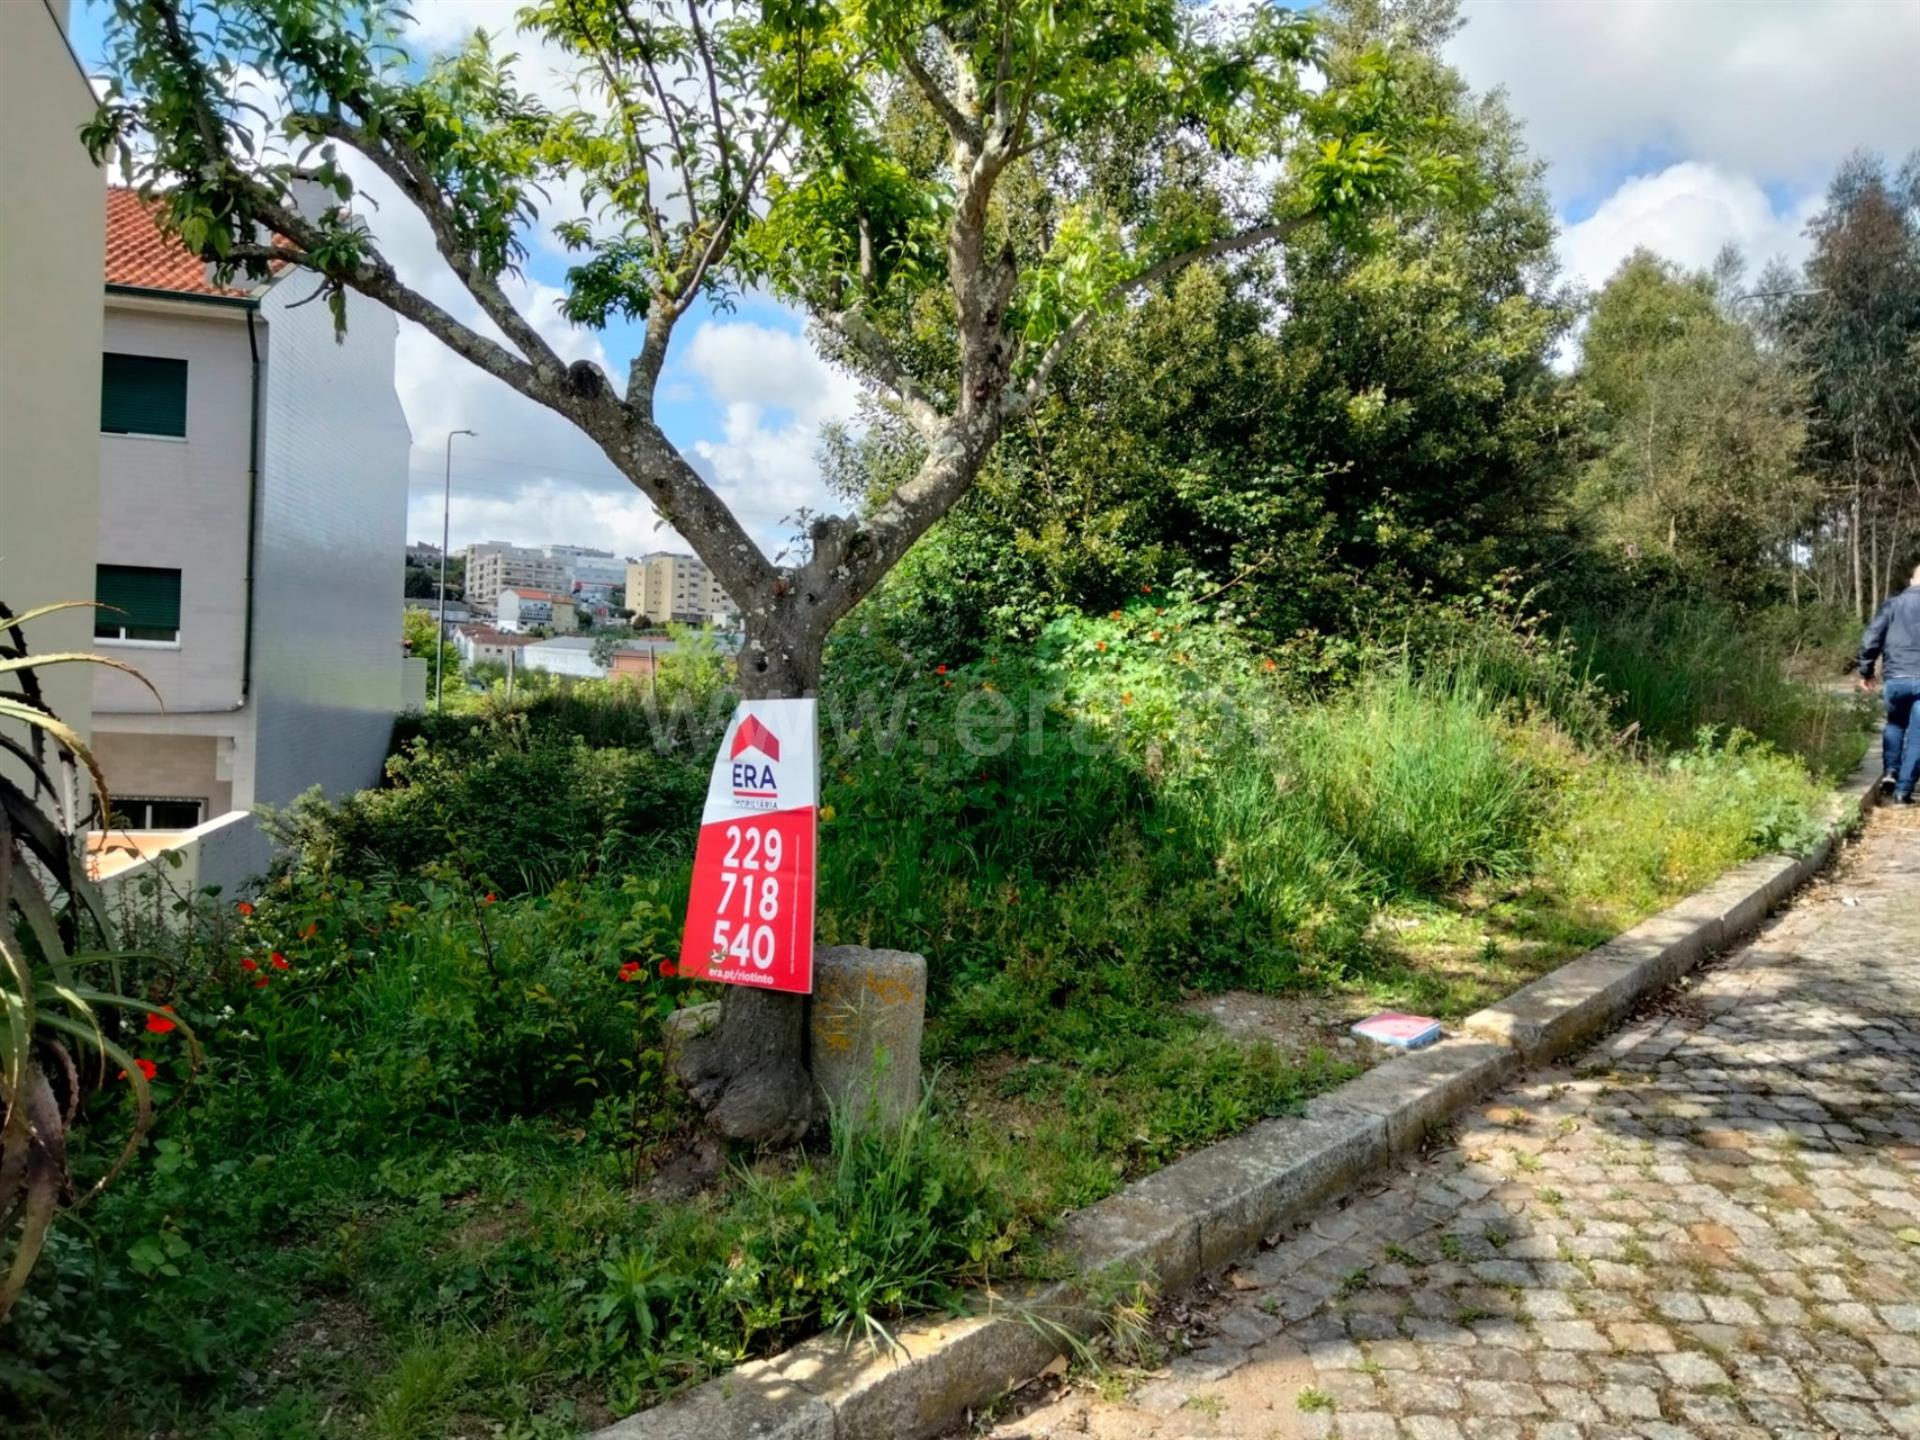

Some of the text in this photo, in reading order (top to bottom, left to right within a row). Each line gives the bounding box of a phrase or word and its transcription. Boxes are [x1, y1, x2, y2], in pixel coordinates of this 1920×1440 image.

[732, 763, 777, 789] ERA
[723, 825, 782, 872] 229
[717, 872, 779, 920] 718
[711, 919, 775, 969] 540
[708, 968, 774, 984] era.pt/riotinto
